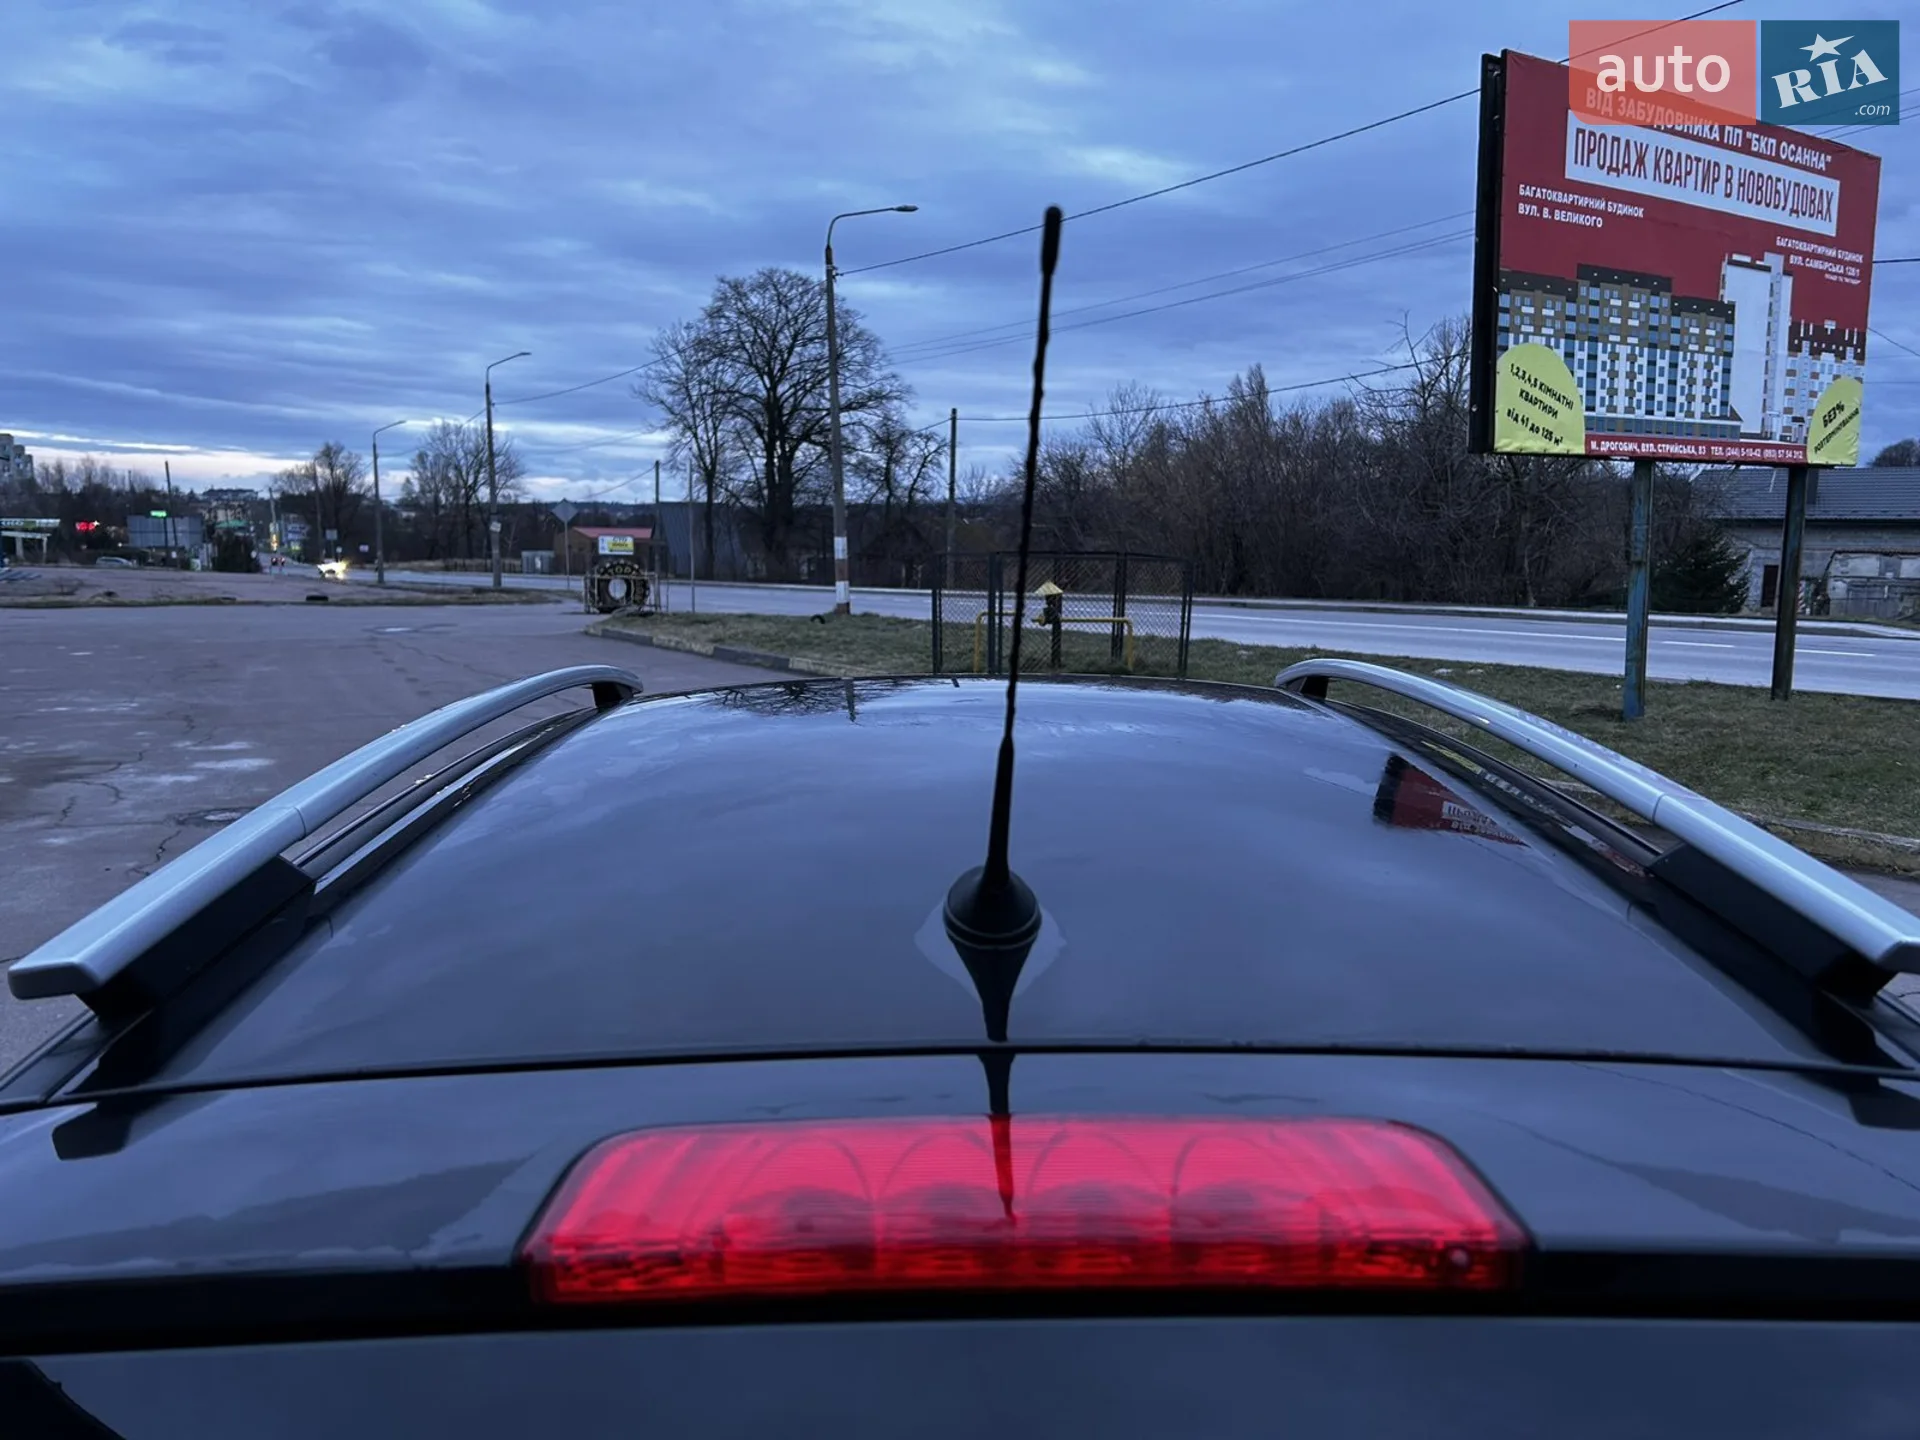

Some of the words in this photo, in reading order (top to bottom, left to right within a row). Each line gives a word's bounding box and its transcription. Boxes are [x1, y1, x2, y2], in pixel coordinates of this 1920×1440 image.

[1585, 87, 1613, 117] ВІД
[1617, 95, 1720, 142] ЗАБУДОВНИКА
[1723, 125, 1743, 148] ПП
[1746, 131, 1777, 157] "БКП
[1780, 141, 1832, 172] ОСАННА"
[1574, 127, 1649, 181] ПРОДАЖ
[1653, 144, 1721, 195] КВАРТИР
[1723, 164, 1734, 199] В
[1737, 167, 1834, 223] НОВОБУДОВАХ
[1518, 184, 1606, 210] БАГАТОКВАРТИРНИЙ
[1607, 202, 1644, 218] БУДИНОК
[1518, 203, 1540, 217] ВУЛ.
[1542, 207, 1552, 219] В.
[1554, 209, 1603, 228] ВЕЛИКОГО
[1776, 236, 1837, 257] БАГАТОКВАРТИРНИЙ
[1837, 249, 1864, 264] БУДИНОК
[1510, 363, 1538, 388] 1,2,3,4,5
[1538, 381, 1574, 410] КІМНАТНІ
[1519, 388, 1559, 419] КВАРТИРИ
[1520, 415, 1529, 428] 41
[1541, 427, 1554, 442] 125
[1590, 440, 1599, 451] М.
[1600, 440, 1640, 454] ДРОГОБИЧ,
[1641, 442, 1656, 453] ВУЛ.
[1657, 442, 1697, 456] СТРИЙСЬКА,
[1710, 446, 1724, 456] ТЕЛ.
